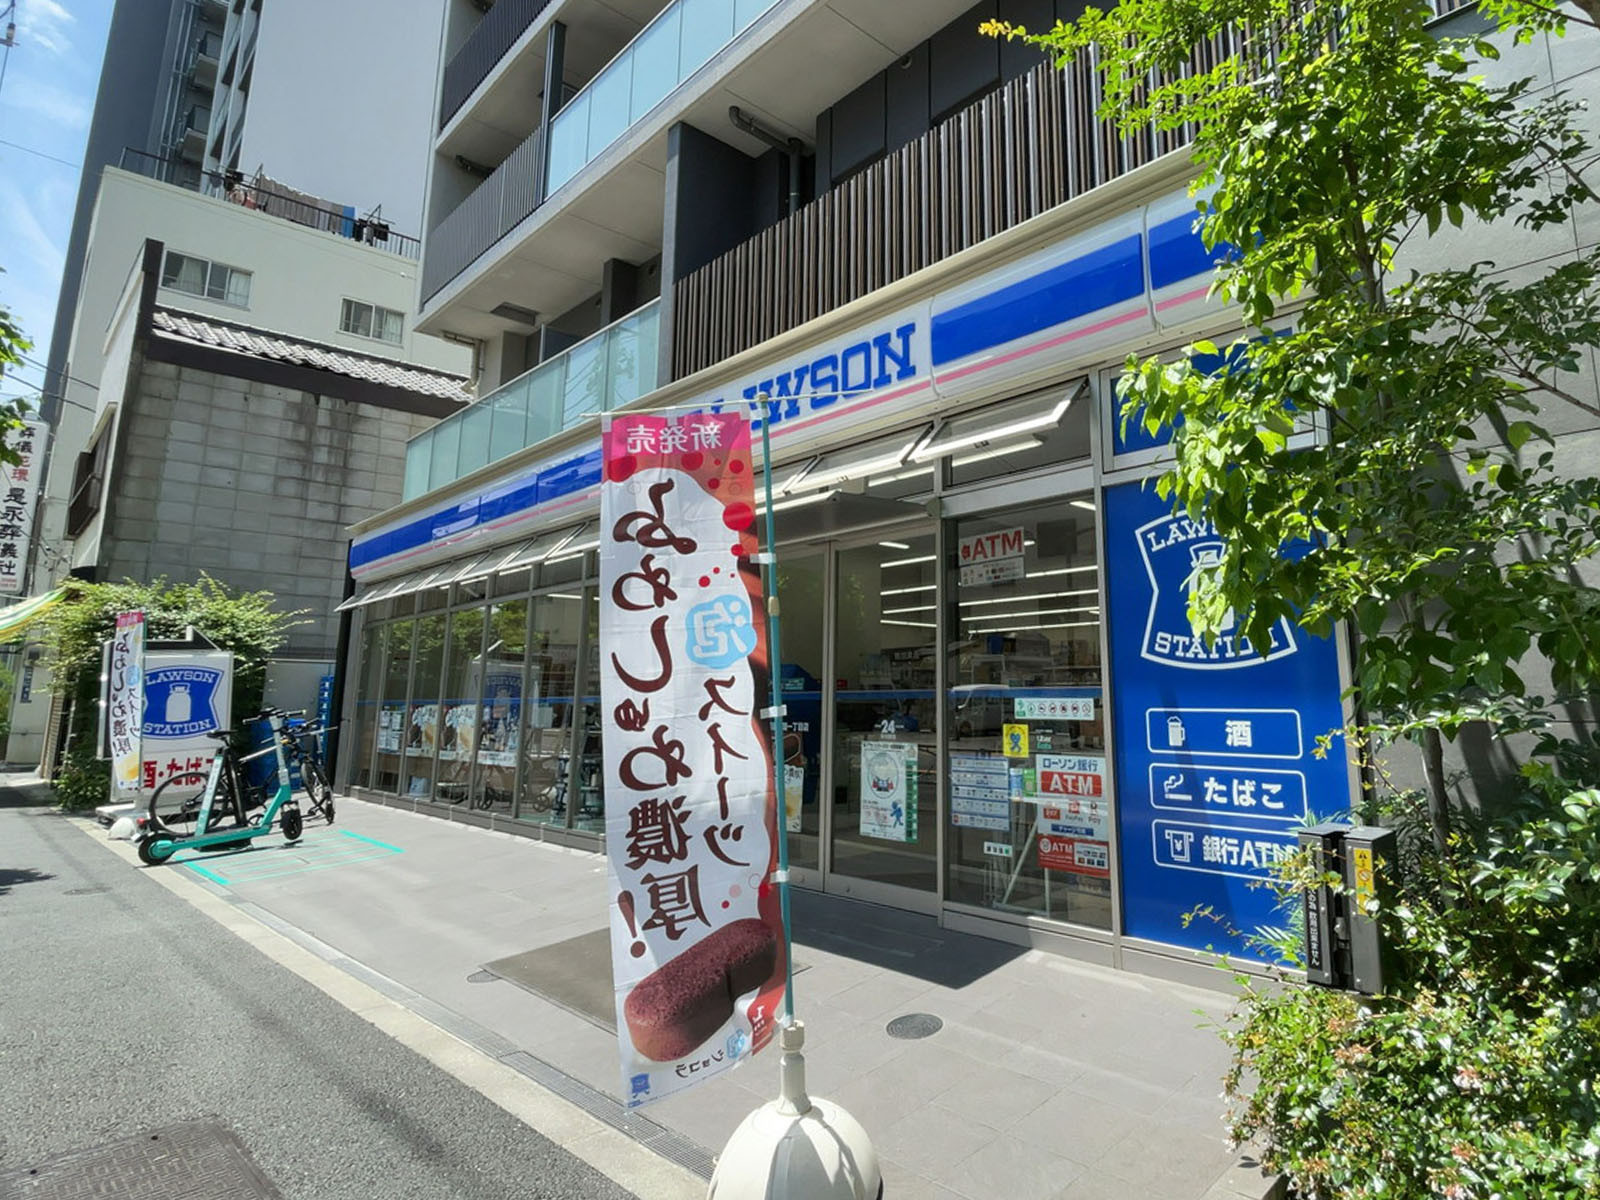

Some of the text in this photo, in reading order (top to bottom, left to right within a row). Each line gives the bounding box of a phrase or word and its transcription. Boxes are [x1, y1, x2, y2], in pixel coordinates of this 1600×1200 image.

[971, 529, 1023, 561] ATM
[145, 670, 216, 686] LAWSON
[142, 718, 213, 736] STATION
[880, 719, 896, 734] 24
[1225, 720, 1252, 747] 酒
[1042, 758, 1098, 772] ローソン銀行
[1049, 773, 1094, 795] ATM
[1203, 778, 1286, 810] たばこ
[1202, 834, 1299, 869] 銀行ATM
